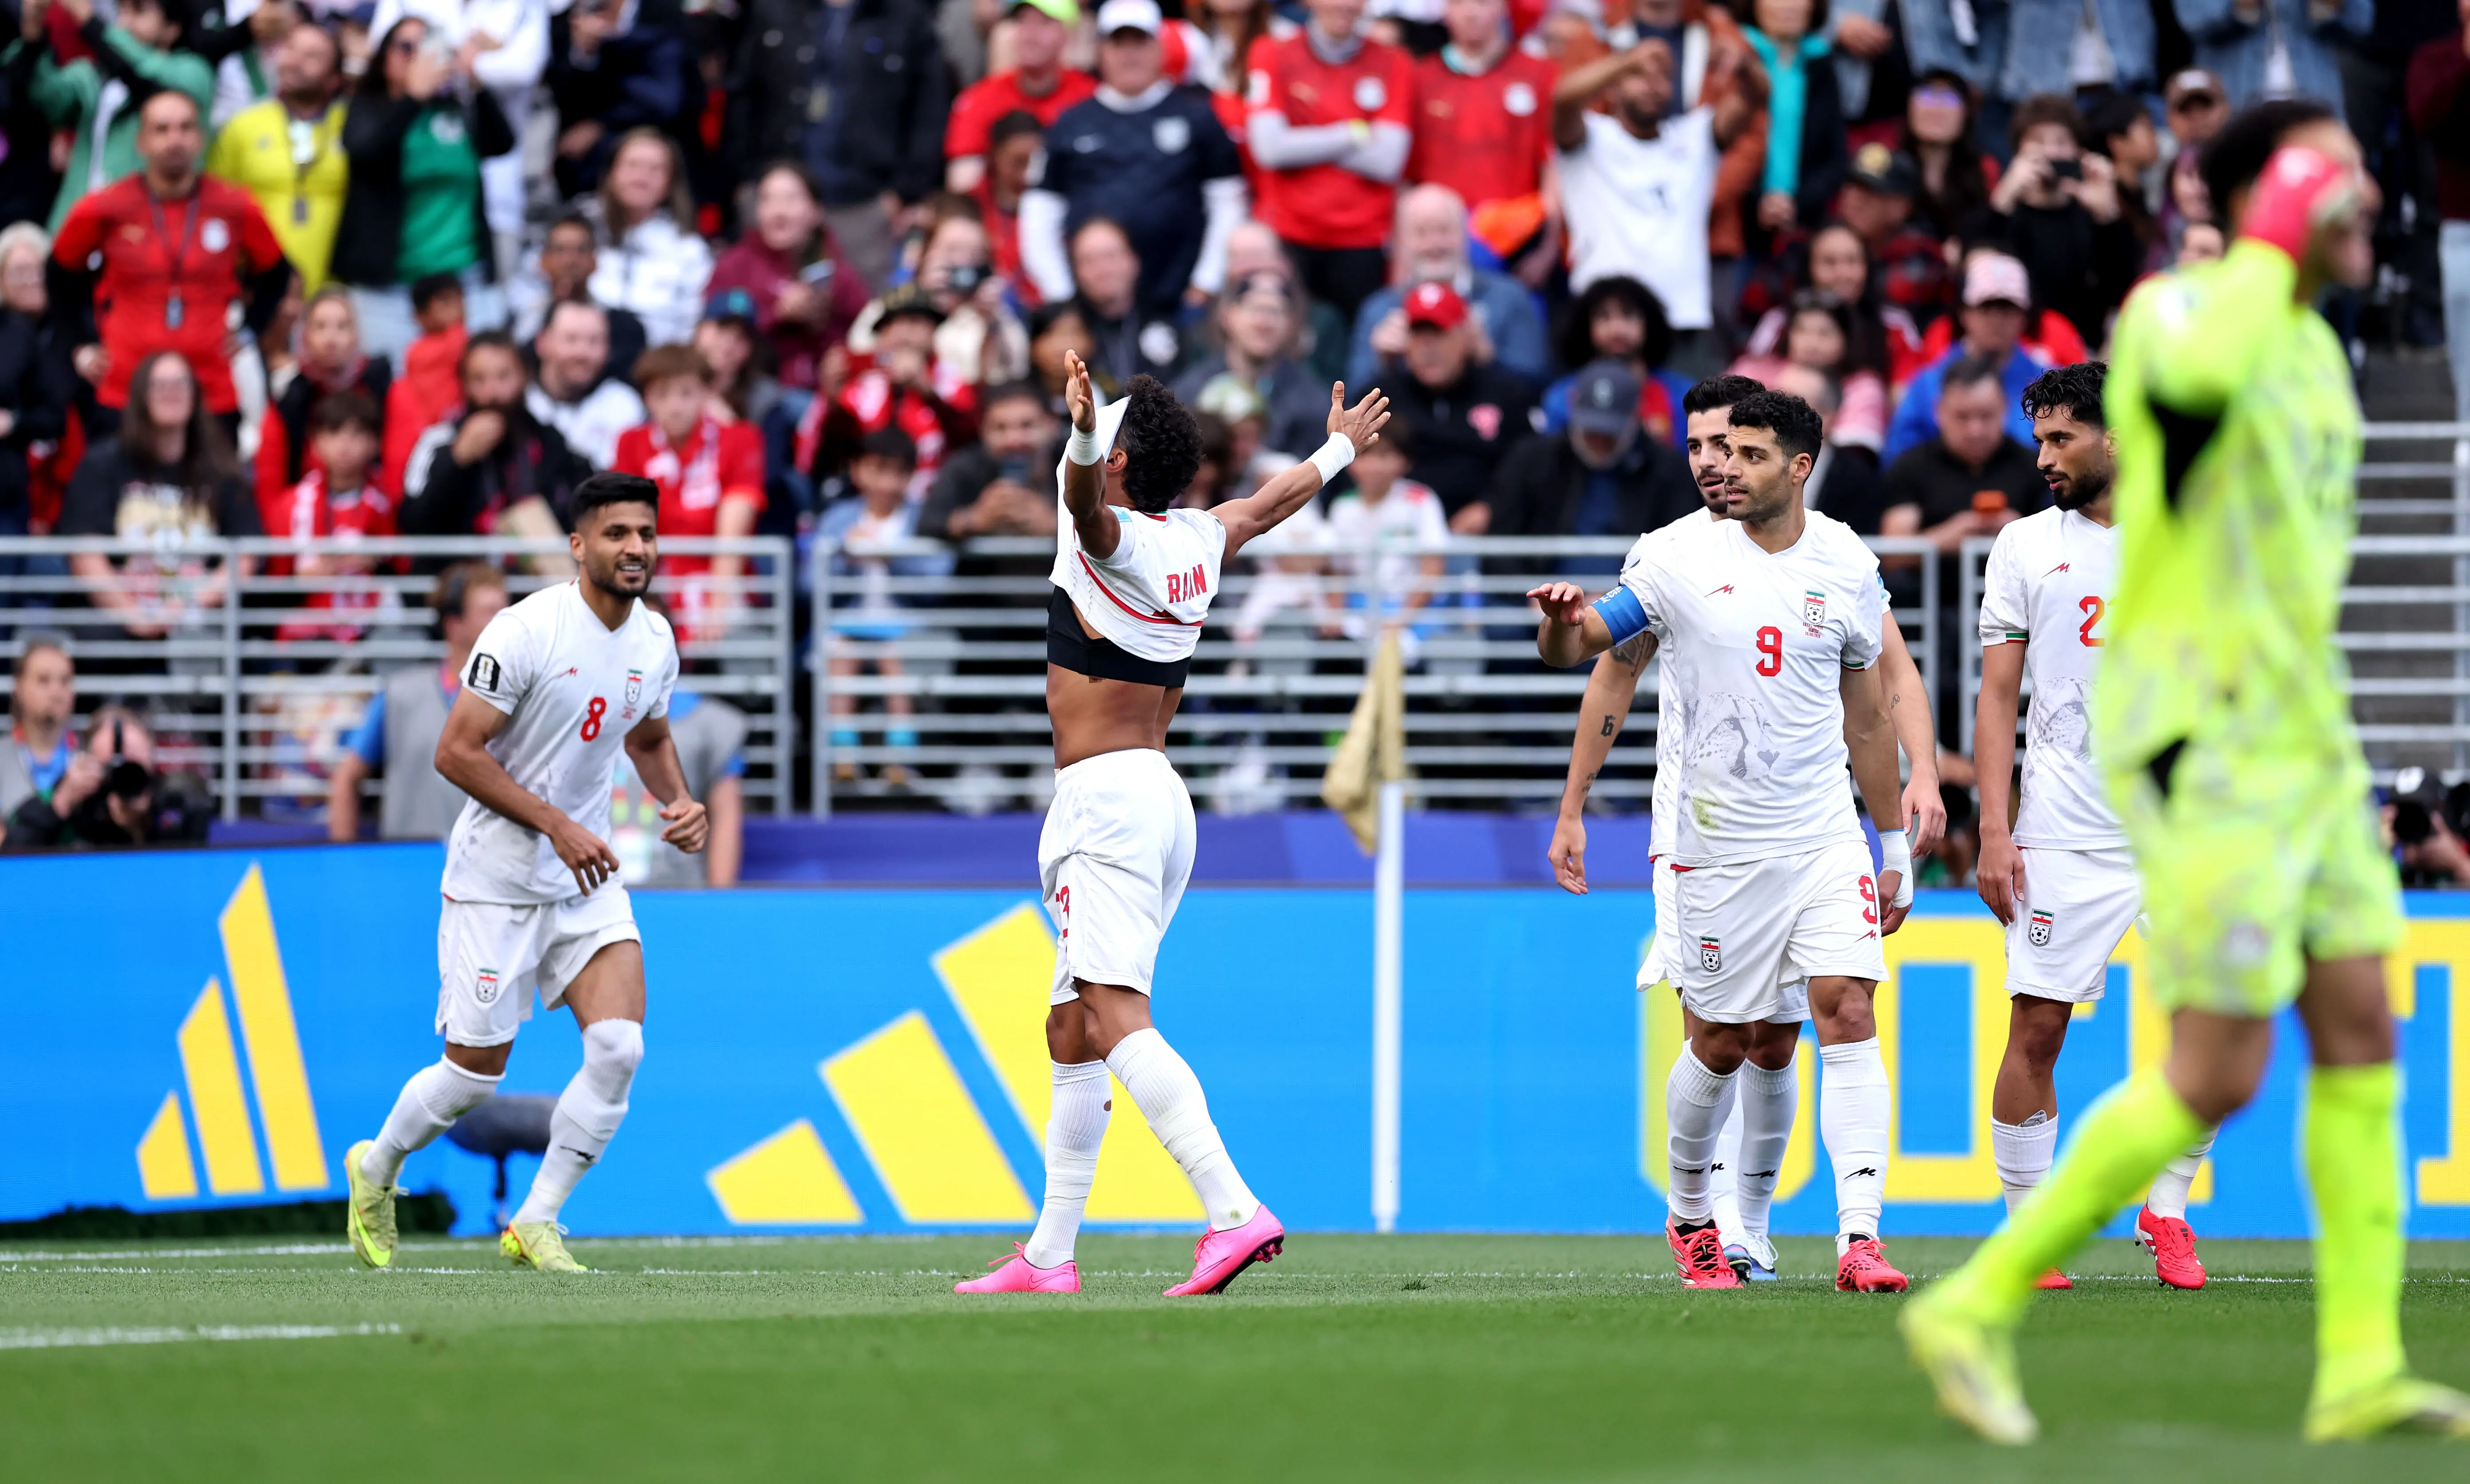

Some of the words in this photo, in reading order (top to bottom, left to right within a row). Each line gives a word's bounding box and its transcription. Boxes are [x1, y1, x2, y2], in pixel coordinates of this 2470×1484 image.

[1756, 626, 1782, 677] 9
[580, 697, 607, 742] 8
[1858, 875, 1878, 925] 9
